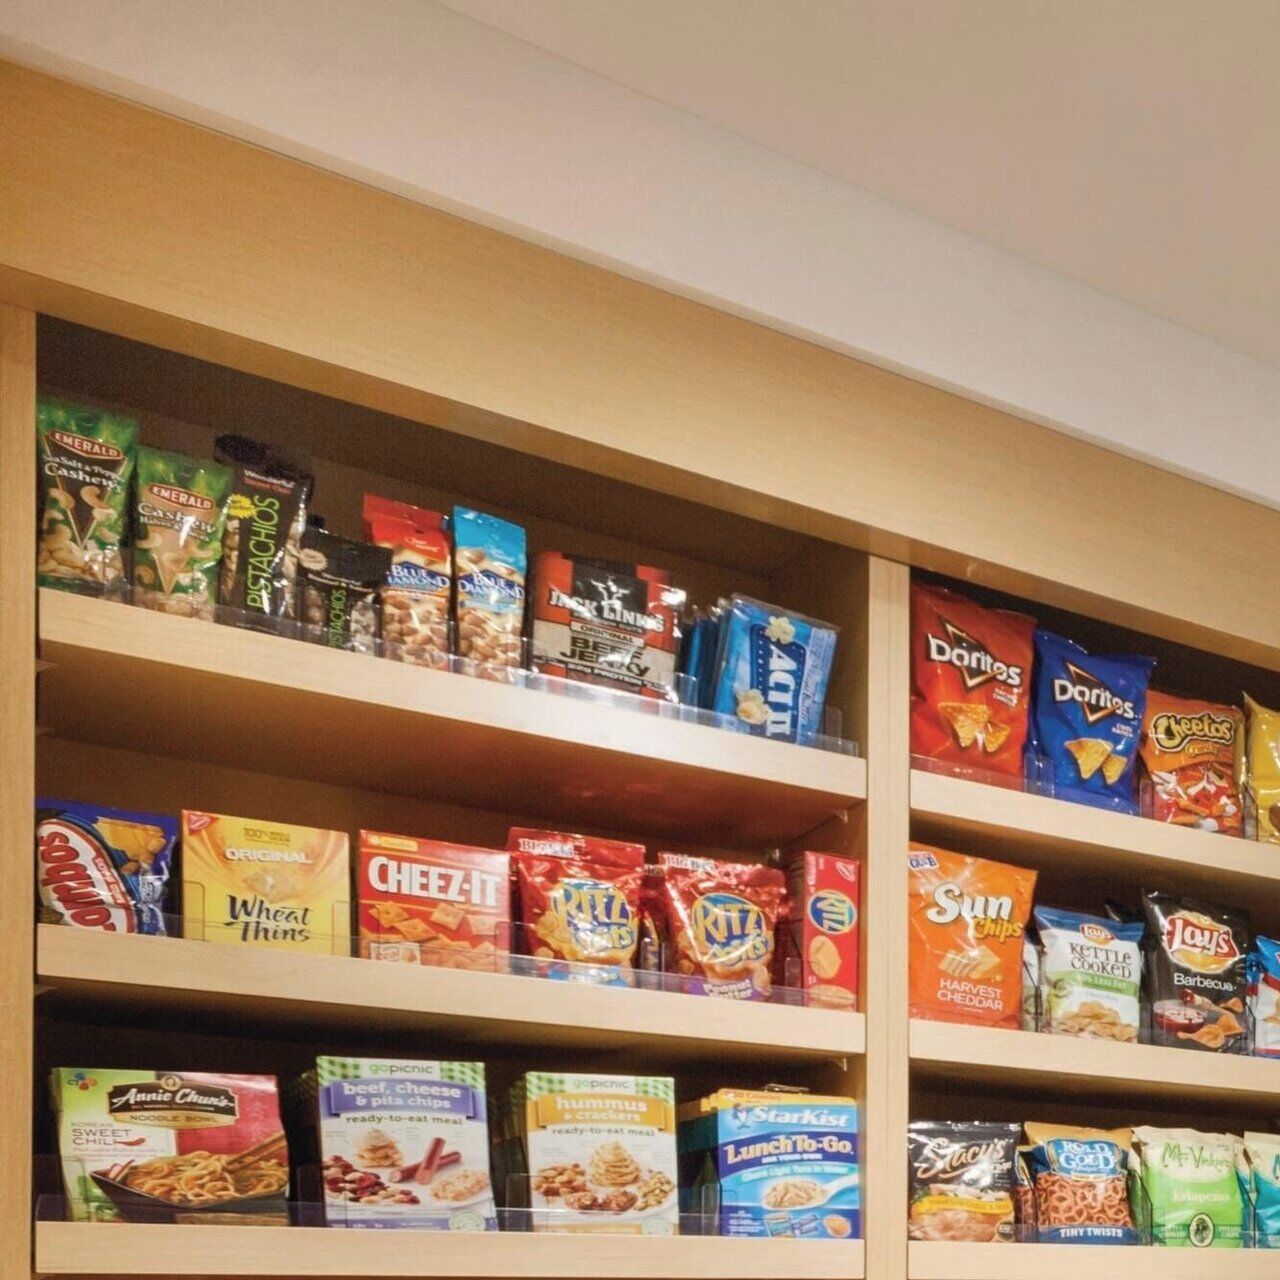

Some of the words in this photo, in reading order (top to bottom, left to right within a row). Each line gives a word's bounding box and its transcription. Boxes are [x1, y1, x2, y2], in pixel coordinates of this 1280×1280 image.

[55, 432, 118, 457] EMERALD
[45, 462, 122, 493] Cashews
[152, 486, 212, 509] EMERALD
[247, 495, 280, 608] PISTACHIOS
[391, 565, 428, 577] BLUE
[927, 633, 1022, 686] Doritos
[1053, 679, 1135, 719] Doritos
[1155, 713, 1234, 749] Cheetos
[225, 848, 313, 864] ORIGINAL
[368, 856, 500, 907] CHEEZ-IT
[227, 894, 312, 925] Wheat
[552, 886, 630, 928] RITZ
[927, 883, 1014, 924] Sun
[696, 900, 760, 941] RITZ
[973, 917, 1024, 942] Chips
[222, 920, 312, 943] Thins
[1171, 918, 1230, 956] Lay's
[1069, 942, 1132, 966] KETTLE
[1071, 958, 1132, 979] COOKED
[939, 979, 1003, 998] HARVEST
[1174, 972, 1234, 991] Barbecue
[937, 991, 1004, 1011] CHEDDAR
[369, 1063, 434, 1075] gopicnic
[342, 1082, 391, 1095] beef,
[395, 1082, 462, 1098] cheese
[573, 1077, 630, 1090] gopicnic
[112, 1088, 171, 1108] Annie
[175, 1087, 235, 1107] Chun's
[355, 1096, 368, 1107] &
[371, 1096, 403, 1108] pita
[408, 1097, 451, 1109] chips
[556, 1098, 648, 1113] hummus
[130, 1113, 180, 1122] NOODLE
[185, 1115, 220, 1123] BOWL
[346, 1115, 429, 1124] ready-to-eat
[432, 1117, 464, 1126] meal
[576, 1110, 641, 1123] crackers
[750, 1105, 849, 1127] StarKist
[72, 1128, 132, 1138] SWEET
[552, 1126, 624, 1138] ready-to-eat
[626, 1127, 656, 1138] meal
[723, 1135, 792, 1165] Lunch
[794, 1134, 854, 1154] To-Go
[917, 1138, 1006, 1179] Stacy's
[1059, 1153, 1115, 1169] GOLD
[1060, 1228, 1085, 1237] TINY
[1087, 1228, 1123, 1238] TWISTS
